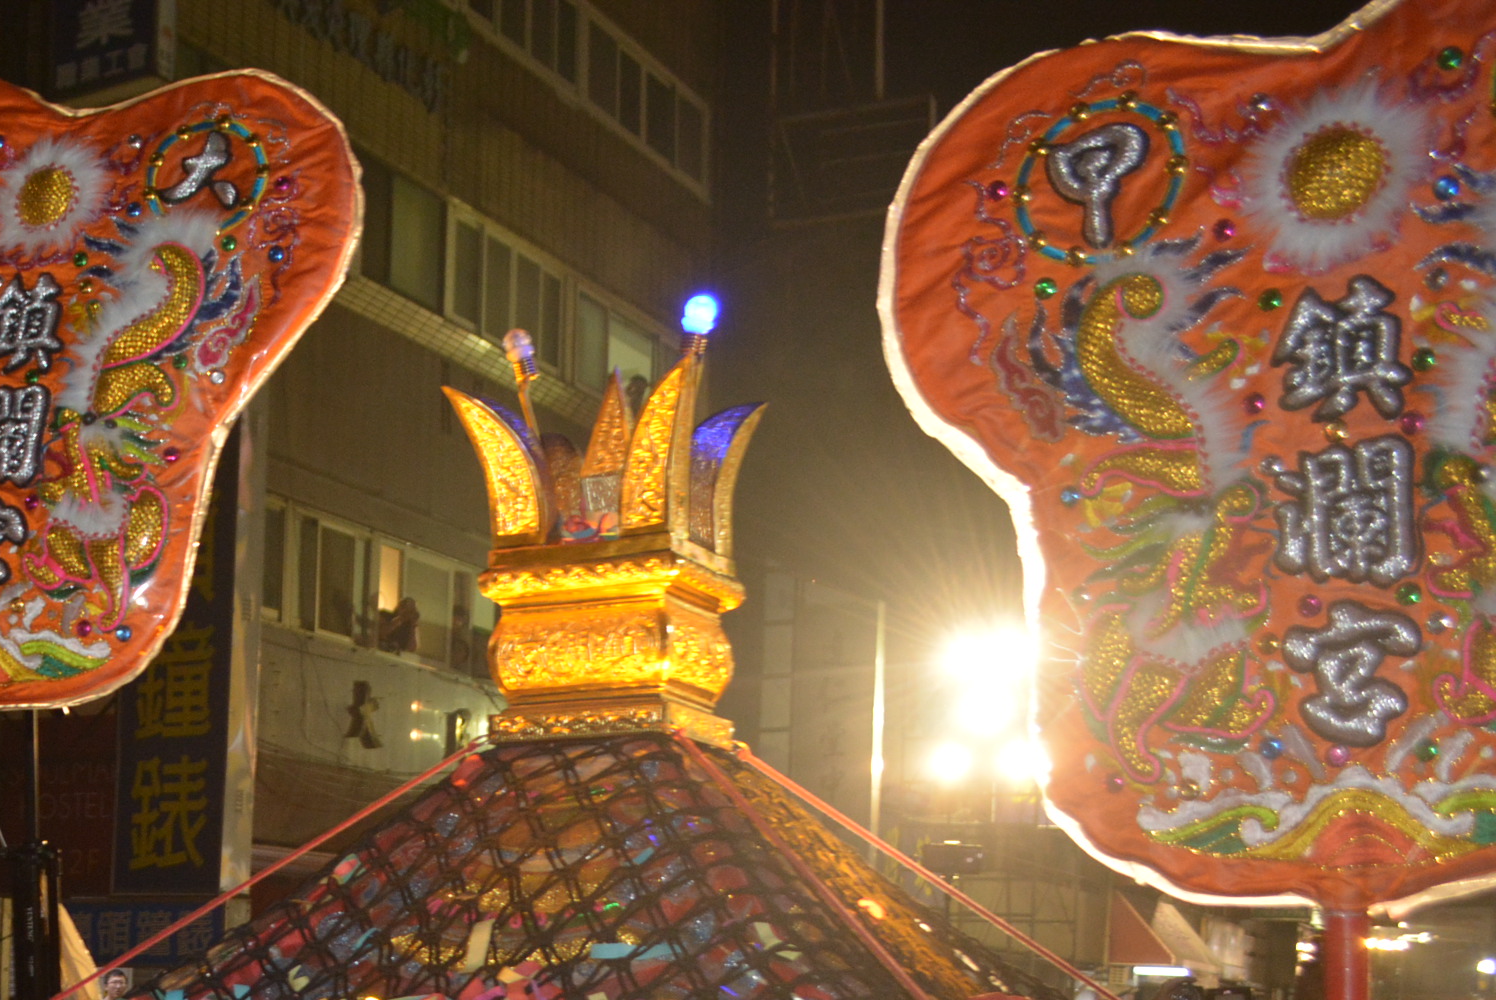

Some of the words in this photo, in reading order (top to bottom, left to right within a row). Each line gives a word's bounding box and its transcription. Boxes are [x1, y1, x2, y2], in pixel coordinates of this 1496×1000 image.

[160, 131, 237, 208] 大
[1044, 122, 1151, 248] 甲
[1271, 274, 1422, 746] 鎮瀾宮
